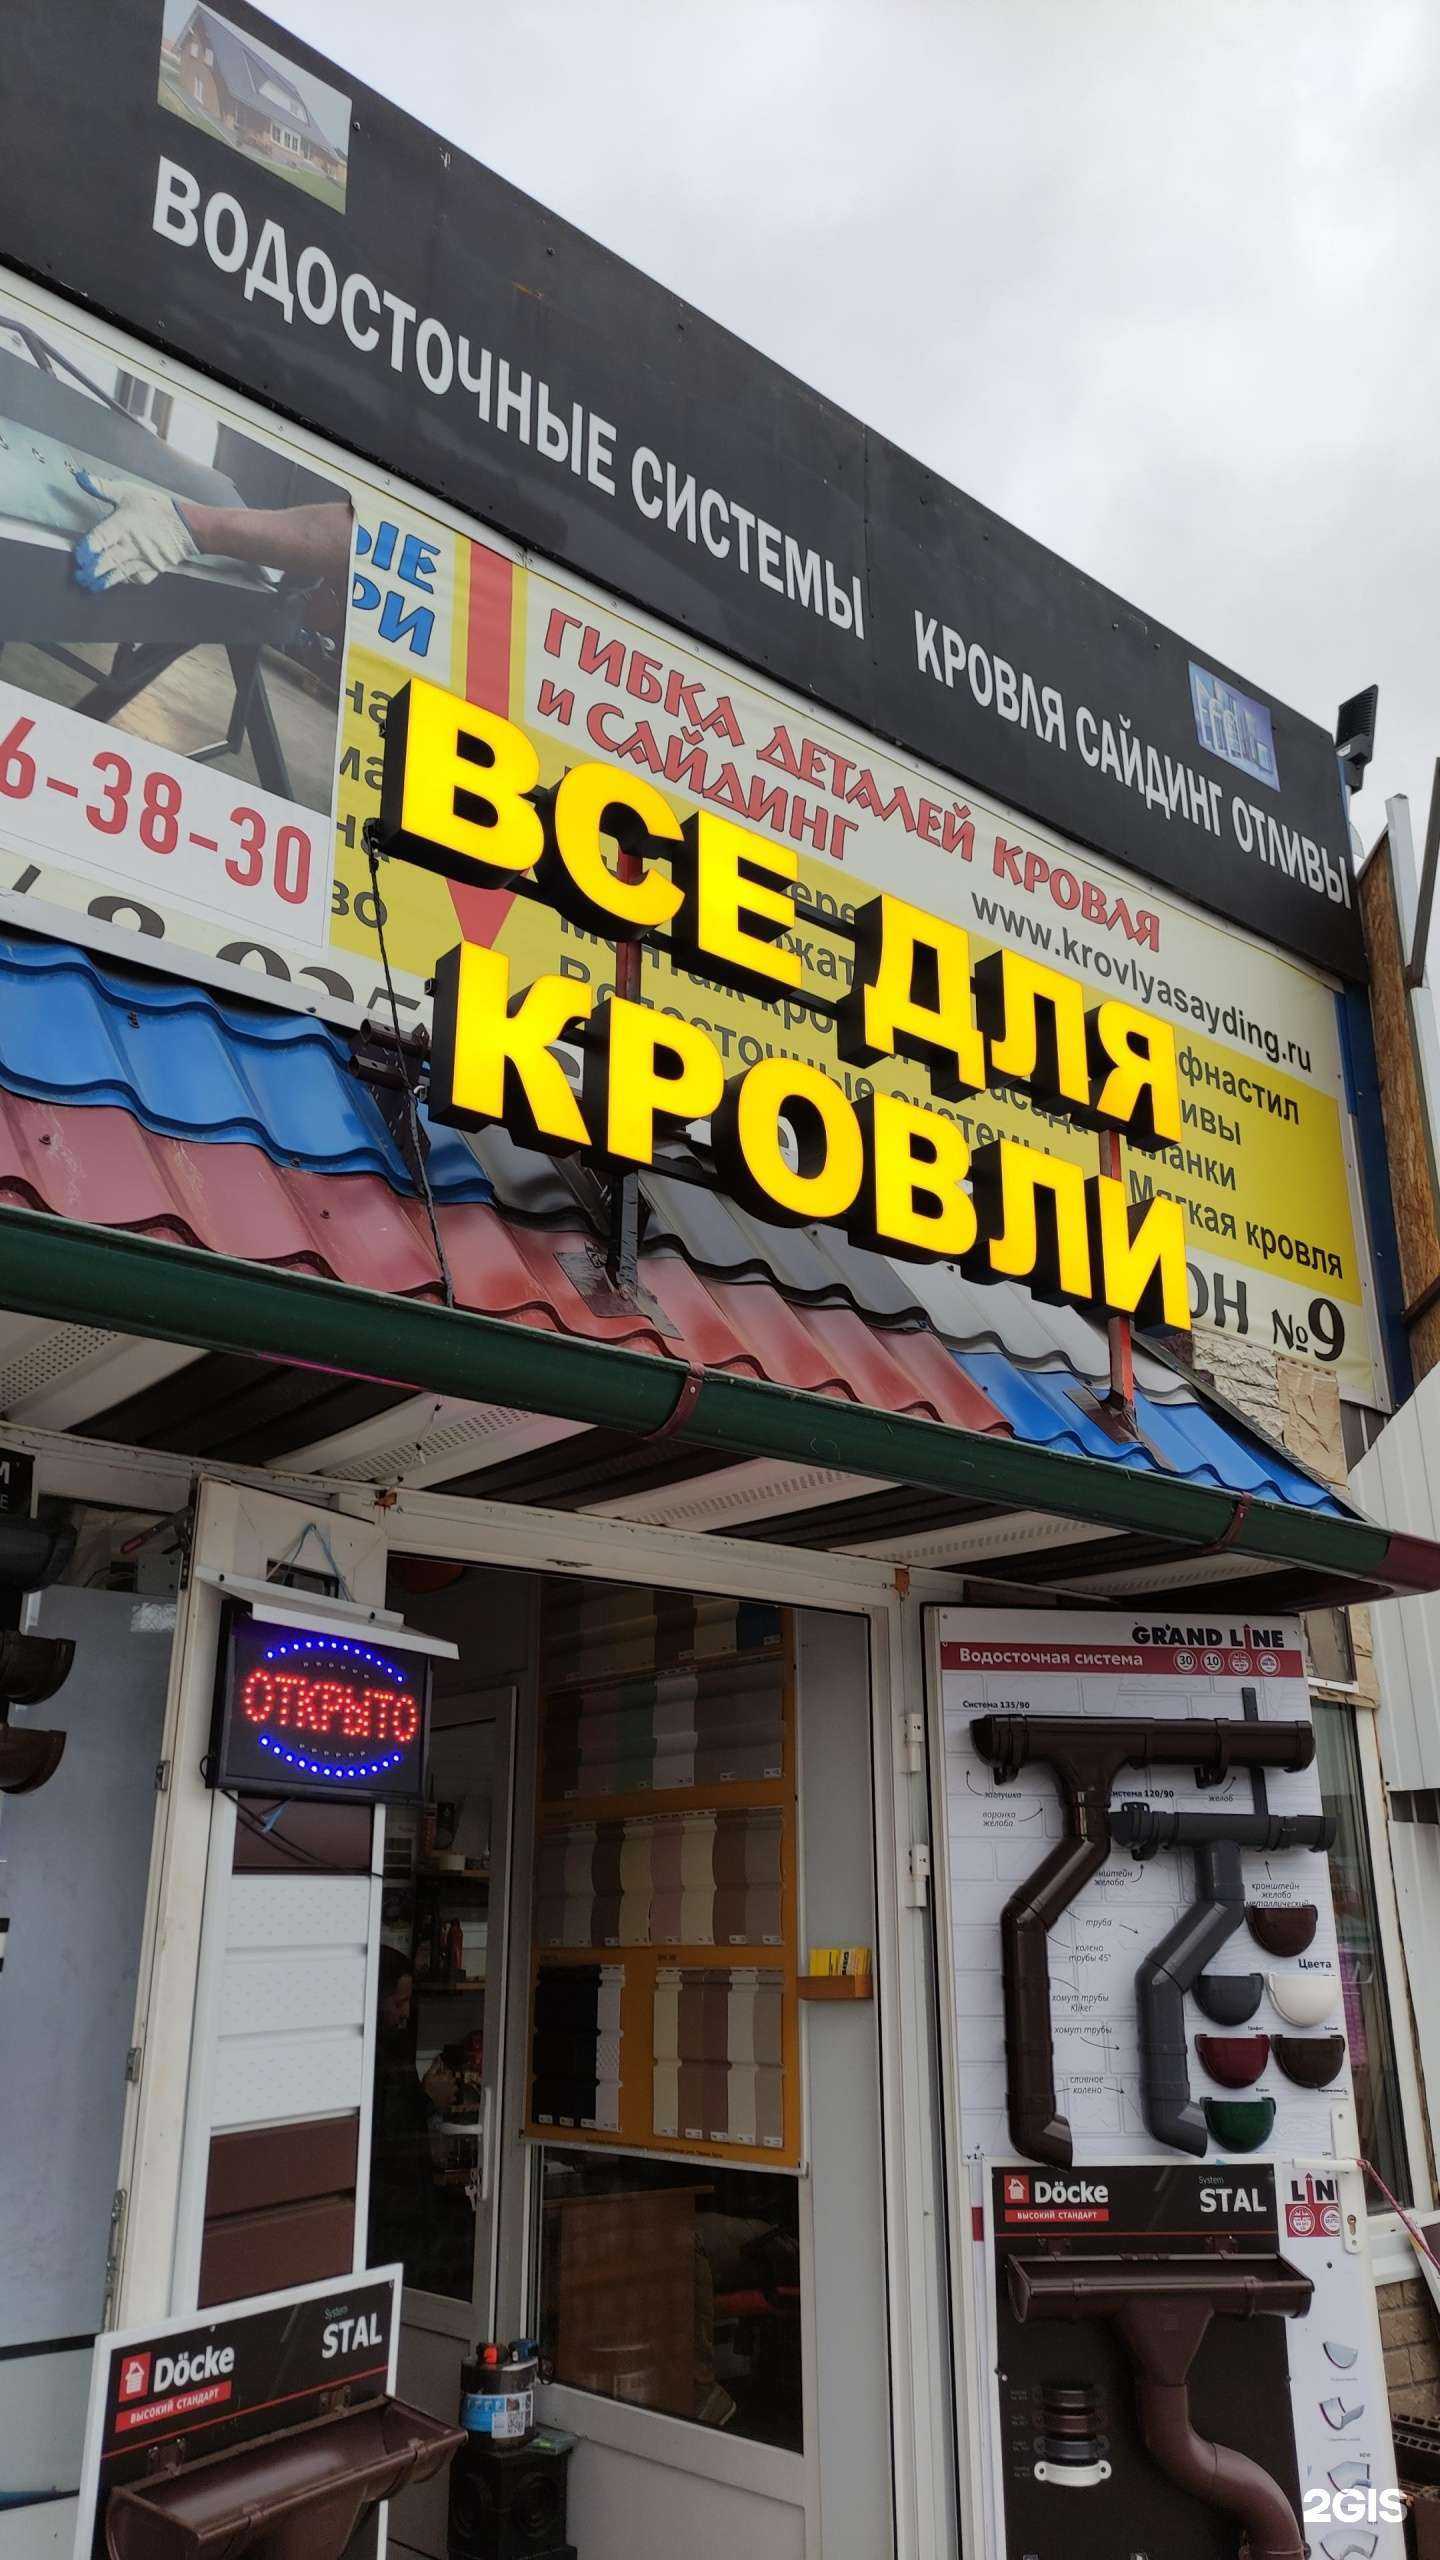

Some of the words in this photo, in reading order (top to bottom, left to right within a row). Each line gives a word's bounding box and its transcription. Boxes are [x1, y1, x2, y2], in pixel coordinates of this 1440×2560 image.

[152, 155, 618, 496] ВОДОСТОЧНЫЕ
[631, 446, 865, 639] СИСТЕМЫ
[914, 610, 1066, 750] КРОВЛЯ
[1076, 705, 1222, 836] САЙДИНГ
[1232, 795, 1350, 907] ОТЛИВЫ
[544, 608, 745, 747] ГИБКА
[757, 725, 976, 862] ДЕТАЛЕЙ
[993, 835, 1160, 952] КРОВЛЯ
[587, 703, 858, 860] САЙДИНГ
[400, 677, 804, 988] ВСЕ
[863, 894, 1183, 1144] ДЛЯ
[971, 890, 1312, 1073] www.krovlyasayding.ru
[1178, 1046, 1300, 1125] фнастил
[1181, 1099, 1241, 1145] ивы
[452, 940, 1193, 1331] КРОВЛИ
[1246, 1220, 1343, 1280] кровля
[1131, 1624, 1223, 1646] GRAND
[1230, 1624, 1285, 1649] LINE
[959, 1647, 1071, 1665] Водосточная
[1075, 1652, 1144, 1667] система
[1179, 1655, 1193, 1666] 30
[1206, 1655, 1220, 1667] 10
[244, 1668, 418, 1744] ОТКРЫТО
[962, 1700, 999, 1709] Система
[1111, 1790, 1142, 1798] истема
[1144, 1789, 1175, 1798] 120/90
[1085, 1918, 1112, 1927] труба
[1069, 1953, 1097, 1963] трубы
[1075, 1944, 1104, 1952] колено
[1298, 1959, 1332, 1970] Цвета
[1081, 1993, 1109, 2003] трубы
[1055, 2026, 1082, 2036] хомут
[1084, 2025, 1112, 2036] трубы
[1073, 2086, 1102, 2095] колено
[1034, 2180, 1109, 2204] Döcke
[1198, 2176, 1224, 2185] System
[1291, 2172, 1339, 2202] LIN
[1199, 2187, 1267, 2213] STAL
[1017, 2210, 1056, 2220] ВЫСОКИЙ
[1059, 2211, 1098, 2220] СТАНДАРТ
[322, 2312, 382, 2359] STAL
[153, 2345, 235, 2393] Döcke
[130, 2402, 174, 2425] ВЫСОКИЙ
[177, 2388, 220, 2411] СТАНДАРТ
